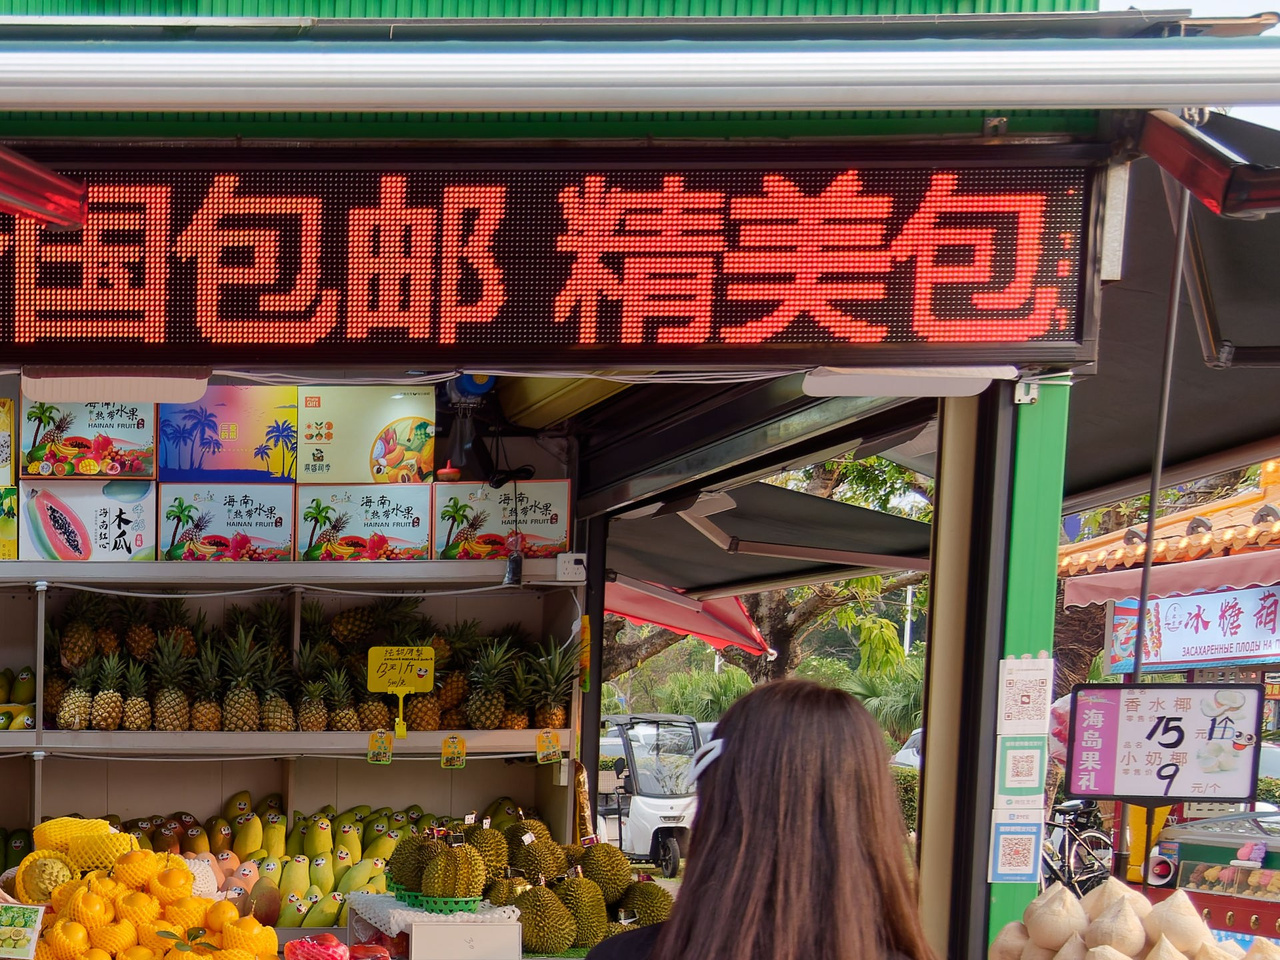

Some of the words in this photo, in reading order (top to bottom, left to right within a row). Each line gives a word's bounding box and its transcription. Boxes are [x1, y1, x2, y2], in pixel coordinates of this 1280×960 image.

[223, 494, 253, 508] 海南
[361, 495, 391, 509] 海南
[498, 492, 529, 507] 海南
[99, 508, 109, 549] 海南红心
[110, 507, 133, 554] 木瓜
[1184, 590, 1280, 637] 冰糖葫
[1182, 643, 1234, 657] ЗАСАХАРЕННЫЕ
[1235, 641, 1261, 653] ПЛОДЫ
[1263, 640, 1273, 651] НА
[1124, 697, 1192, 713] 香水椰
[1145, 715, 1184, 749] 15
[1077, 708, 1105, 791] 海岛果礼
[1120, 751, 1188, 767] 小奶椰
[1156, 763, 1180, 796] 9
[1191, 783, 1221, 794] 元/个
